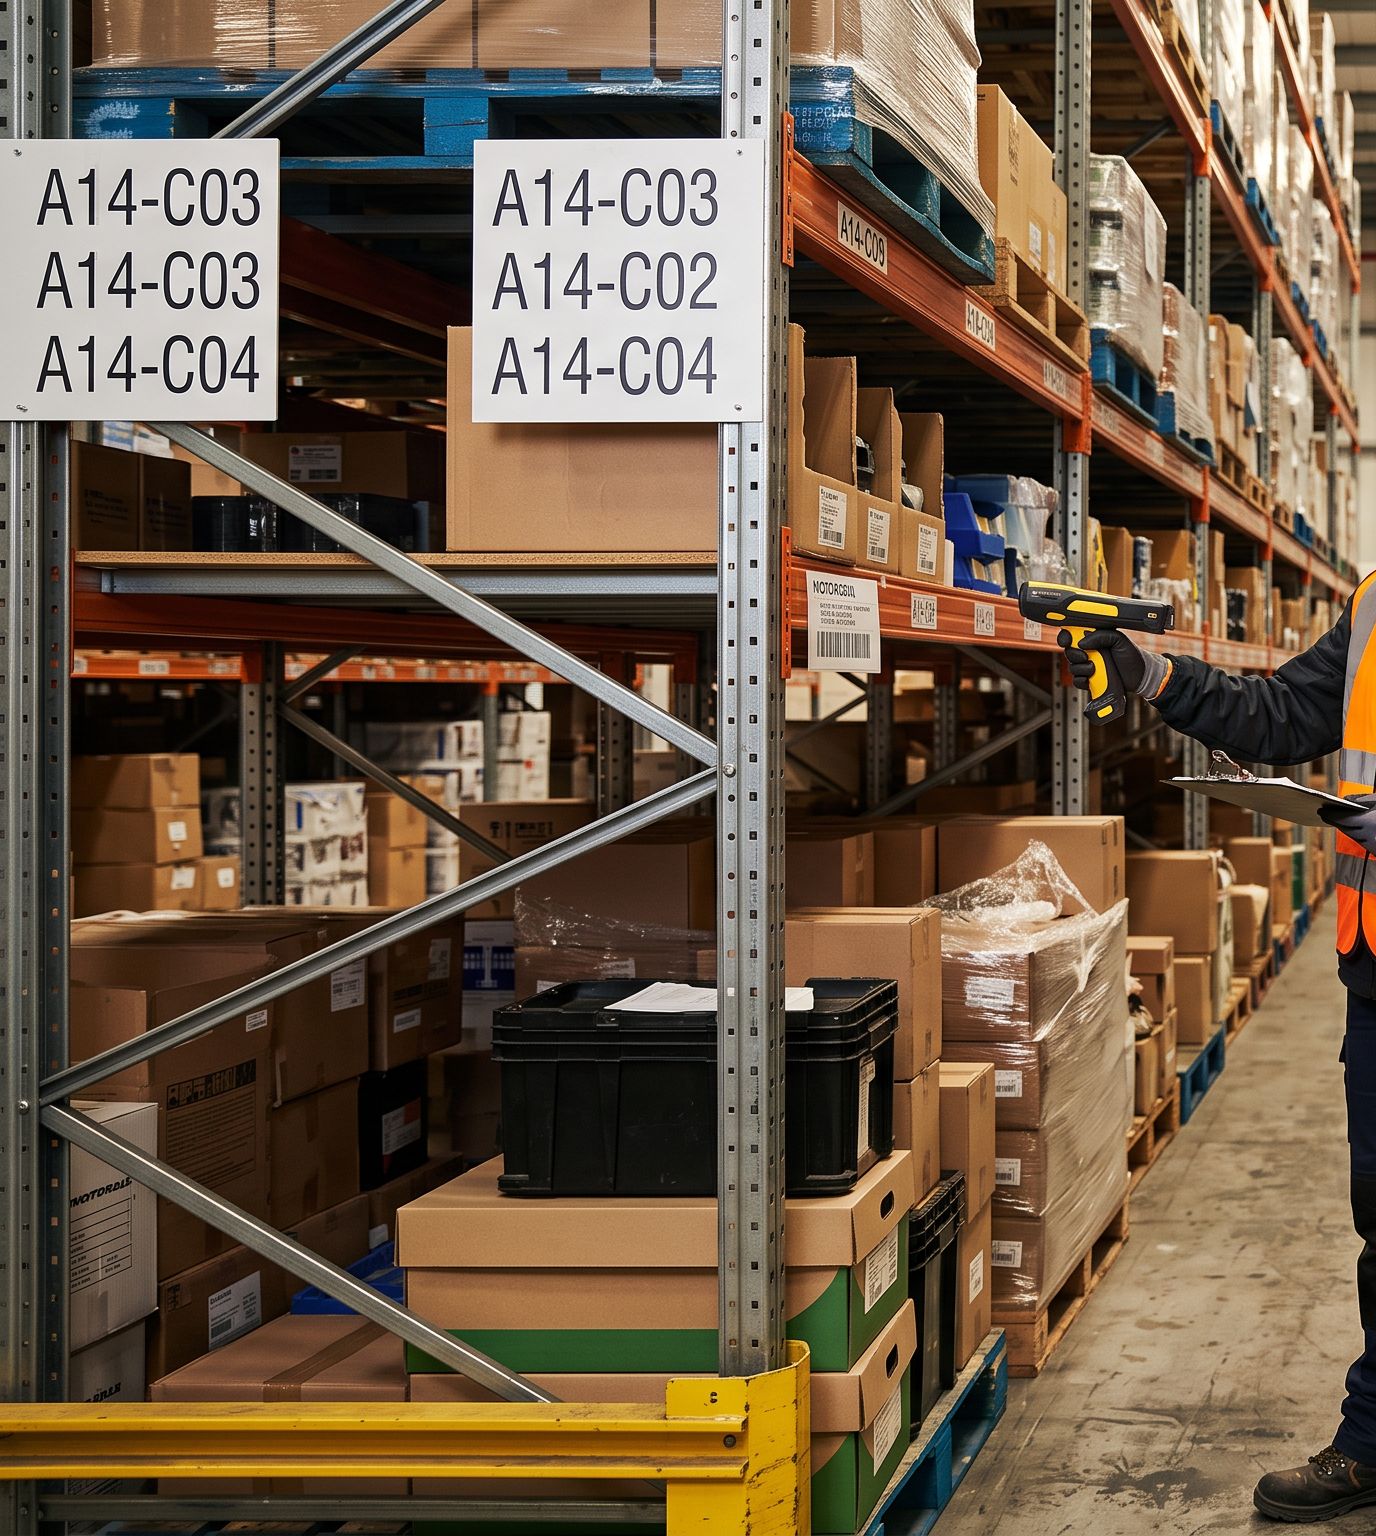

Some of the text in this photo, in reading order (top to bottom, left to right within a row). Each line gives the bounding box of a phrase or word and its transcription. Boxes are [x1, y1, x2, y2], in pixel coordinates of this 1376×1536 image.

[36, 167, 261, 227] A14-C03
[492, 167, 718, 227] A14-C03
[36, 250, 260, 310] A14-C03
[491, 251, 717, 311] A14-C02
[36, 334, 260, 394] A14-C04
[491, 335, 717, 396] A14-C04
